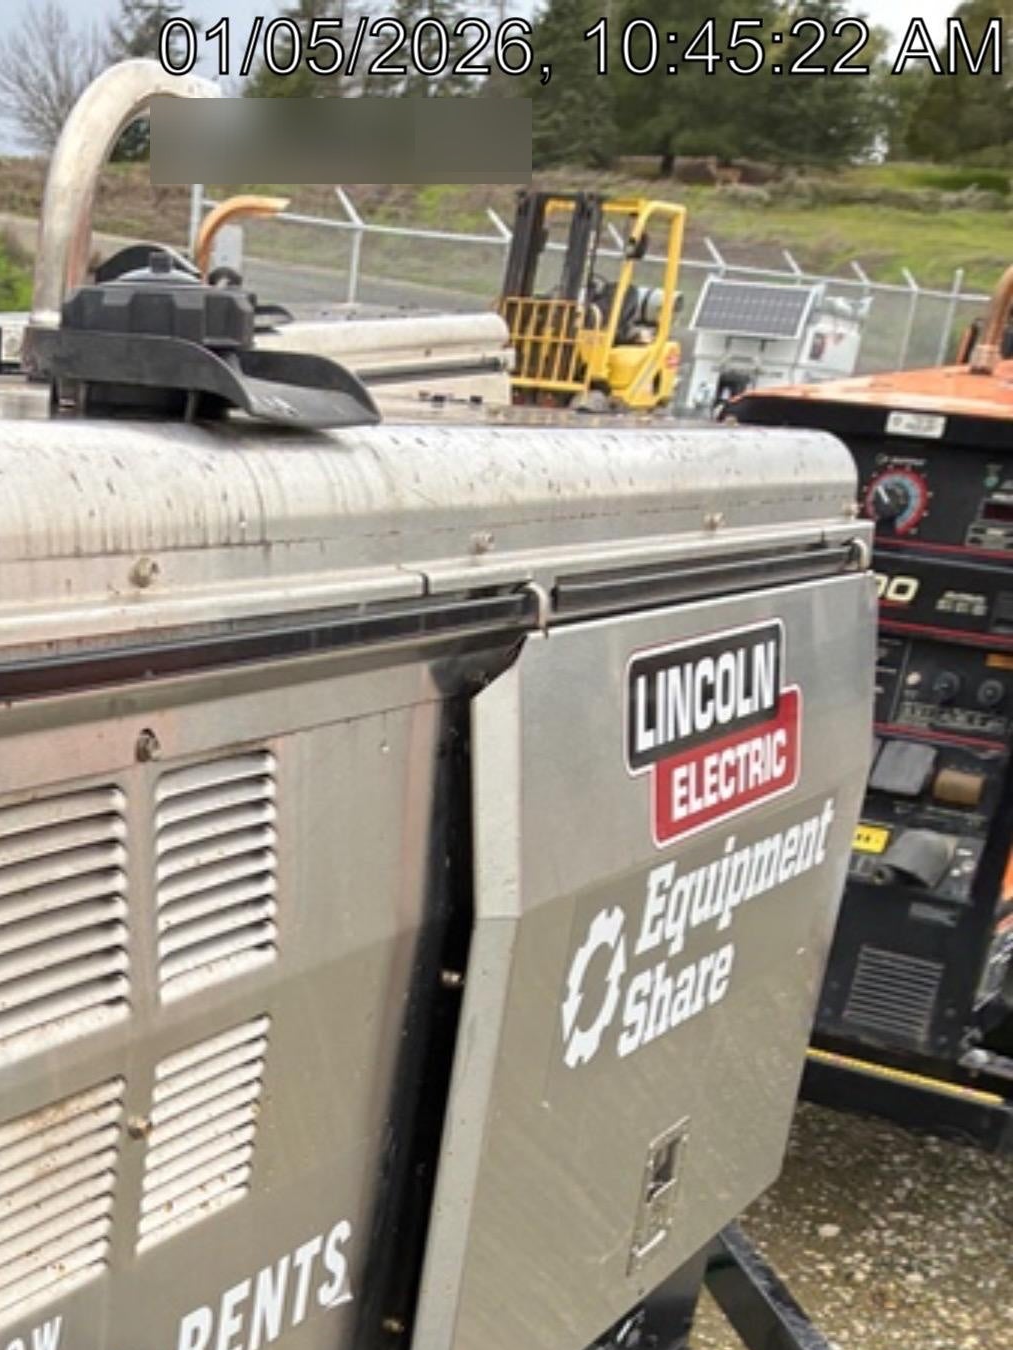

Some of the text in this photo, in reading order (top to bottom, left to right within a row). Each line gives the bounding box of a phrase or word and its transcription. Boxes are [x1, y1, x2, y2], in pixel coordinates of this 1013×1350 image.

[637, 640, 776, 753] LINCOLN
[671, 727, 787, 823] ELECTRIC
[634, 798, 835, 957] Equipment
[617, 943, 735, 1058] Share
